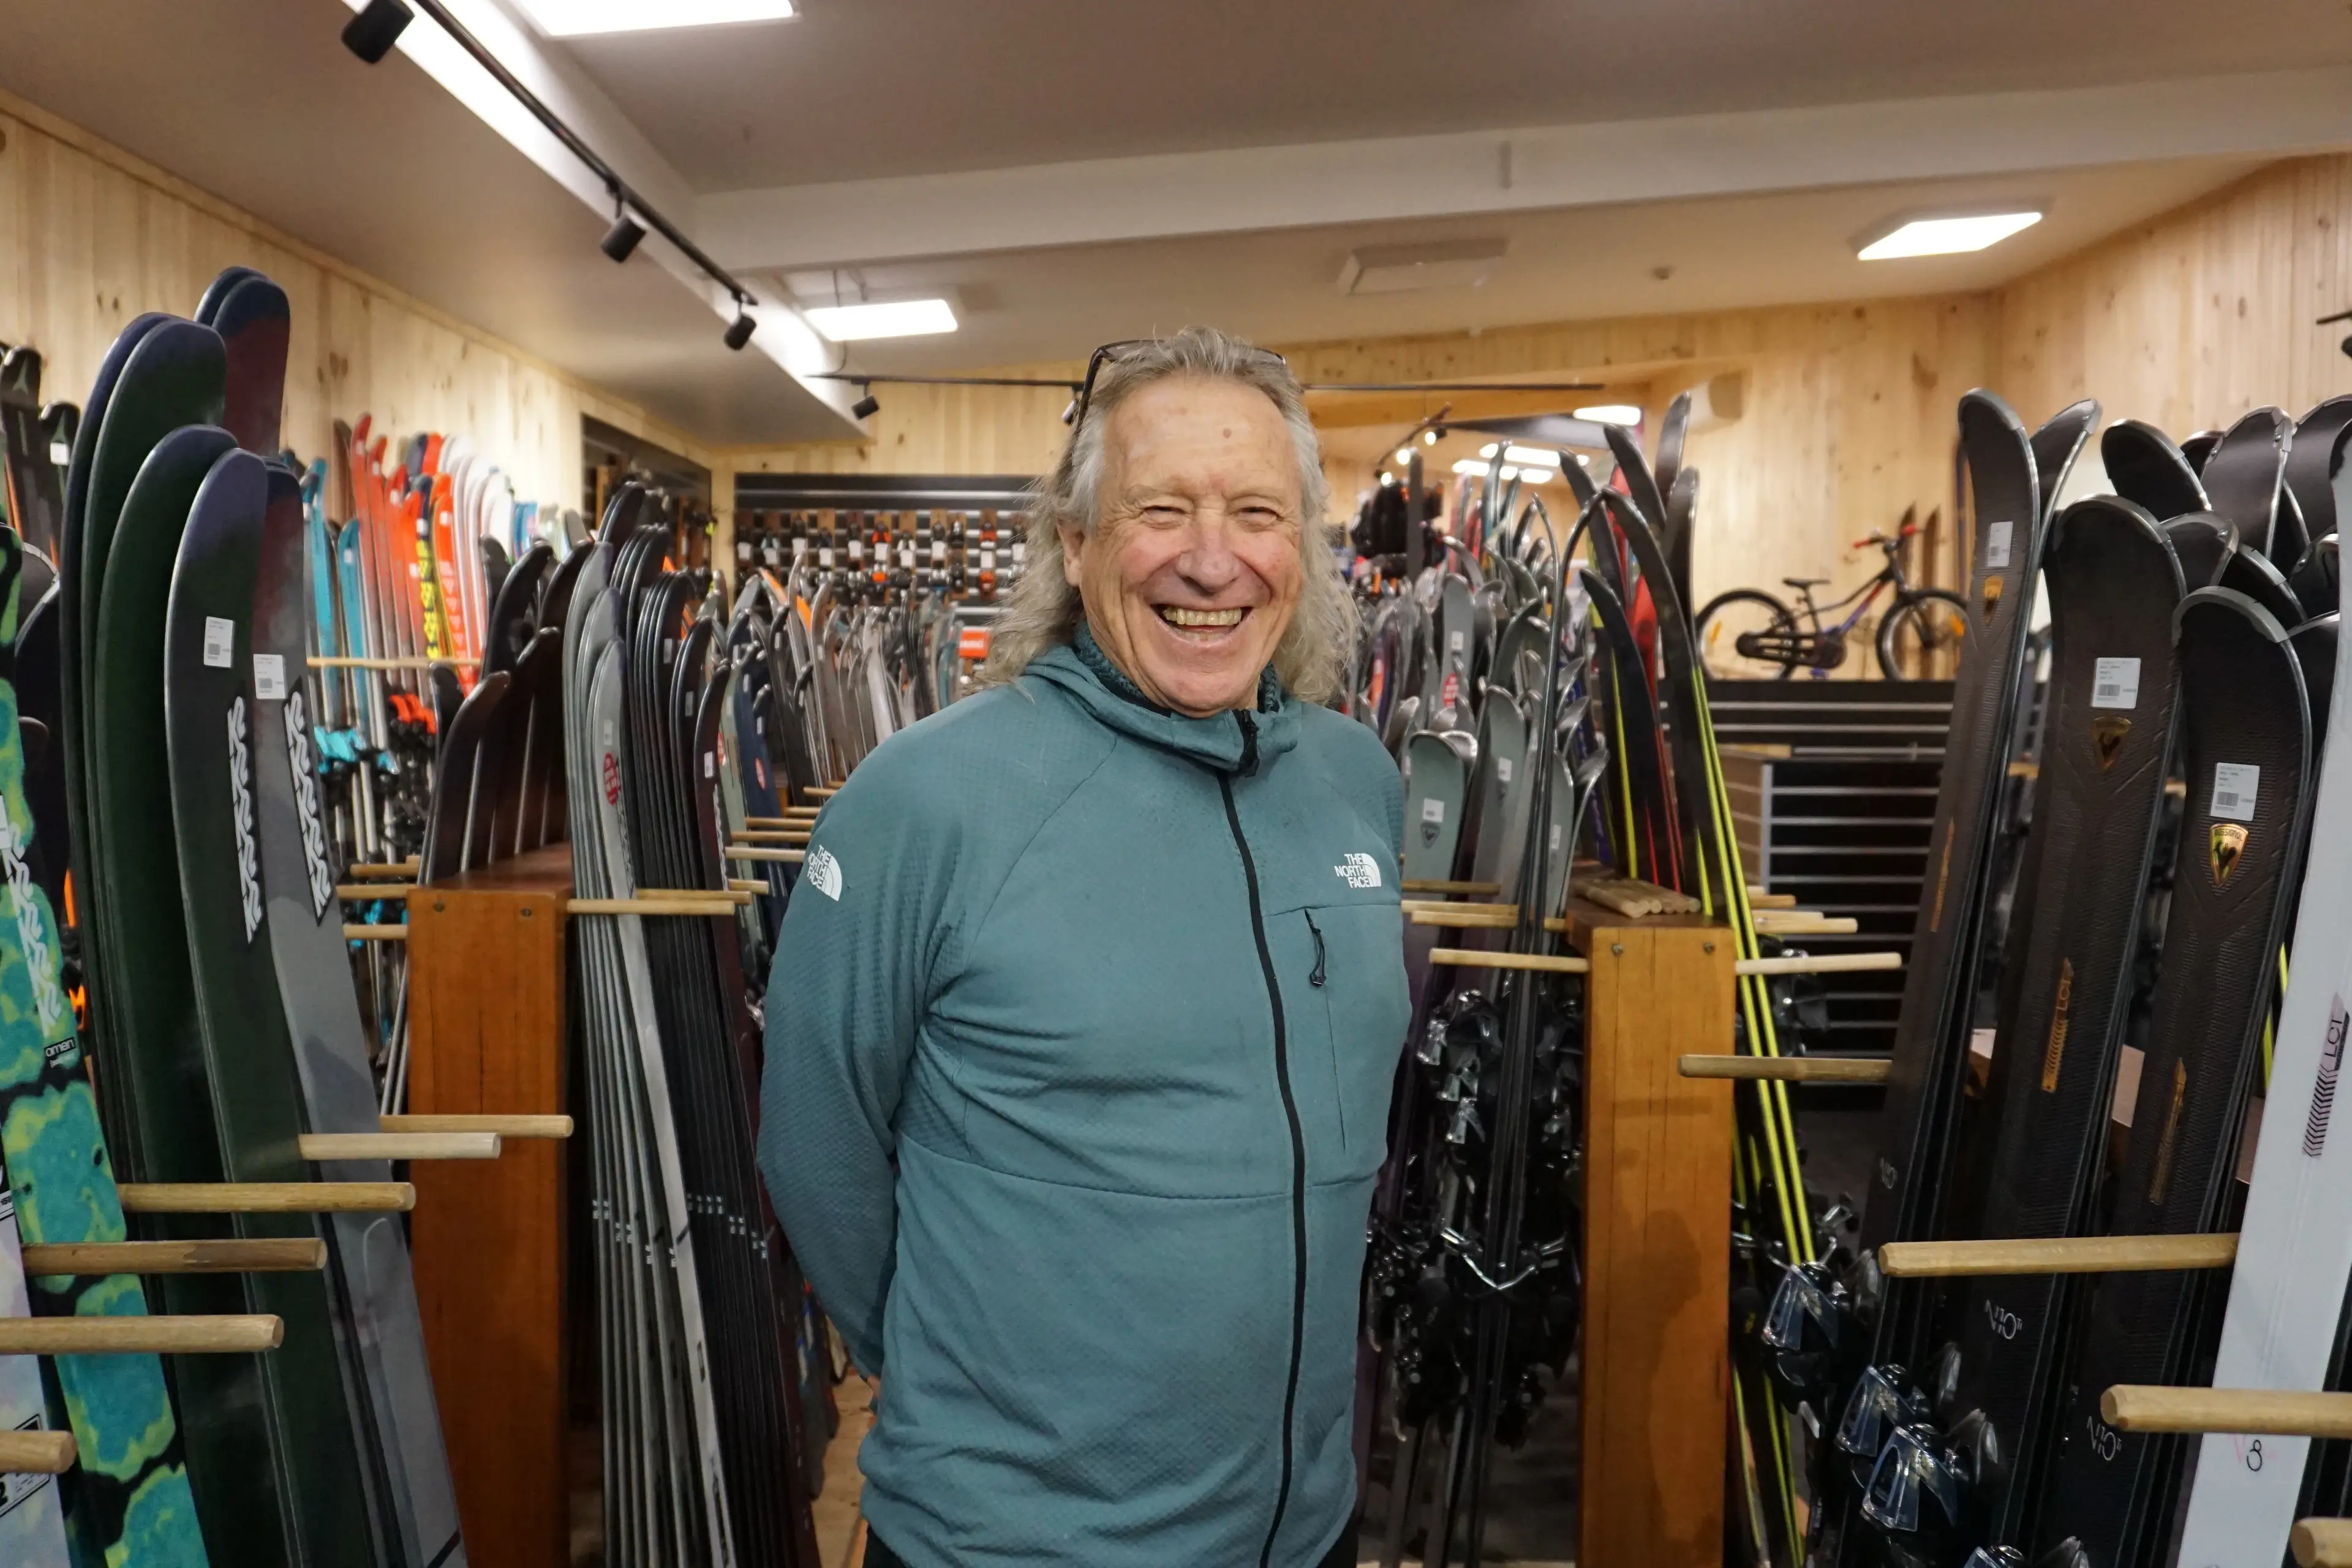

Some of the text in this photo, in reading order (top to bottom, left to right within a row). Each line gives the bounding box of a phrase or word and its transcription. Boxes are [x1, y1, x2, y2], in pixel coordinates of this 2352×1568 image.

[817, 845, 832, 865] THE
[1344, 853, 1363, 865] THE
[807, 865, 824, 890] FACE
[1334, 865, 1366, 876] NORTH
[1348, 876, 1371, 888] FACE
[45, 1039, 74, 1057] omen
